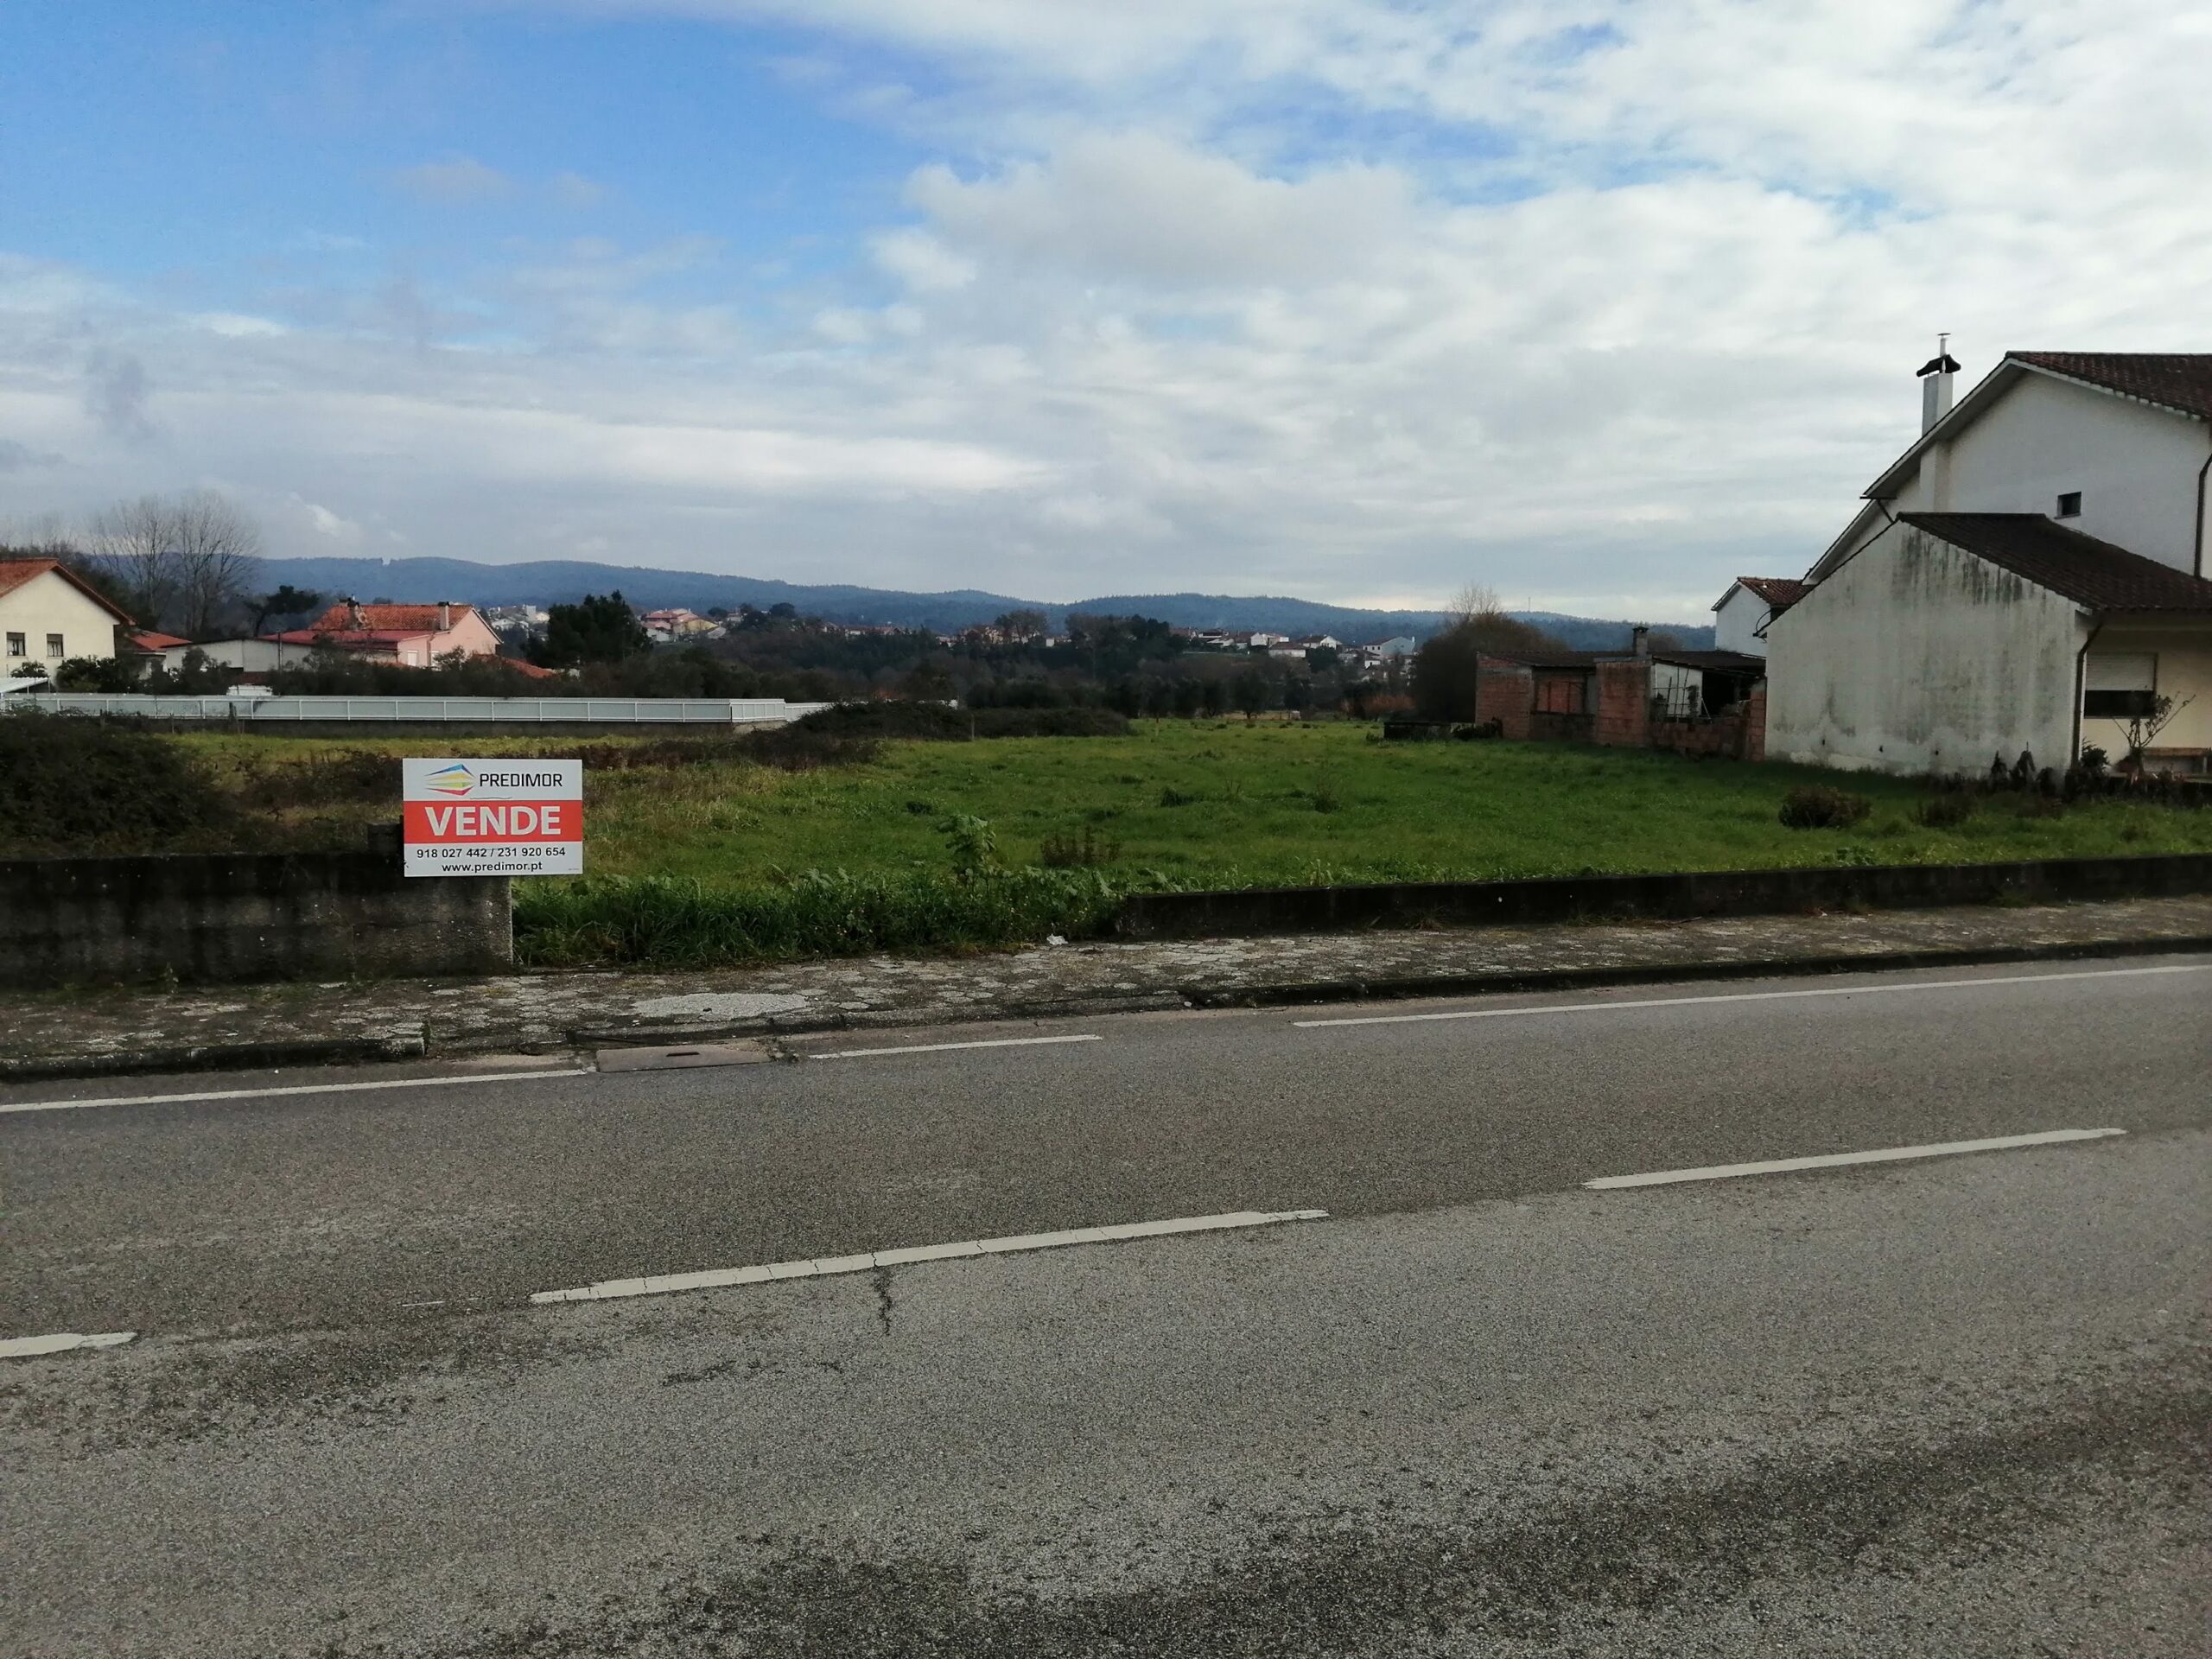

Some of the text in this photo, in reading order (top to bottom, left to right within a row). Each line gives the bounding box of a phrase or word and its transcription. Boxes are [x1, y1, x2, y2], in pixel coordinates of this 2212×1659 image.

[480, 773, 563, 787] PREDIMOR
[424, 805, 561, 836] VENDE
[416, 849, 438, 858] 918
[442, 849, 461, 858] 027
[467, 848, 487, 857] 442
[498, 848, 517, 857] 231
[522, 848, 542, 857] 920
[545, 847, 566, 856] 654
[442, 861, 543, 874] www.predimor.pt
